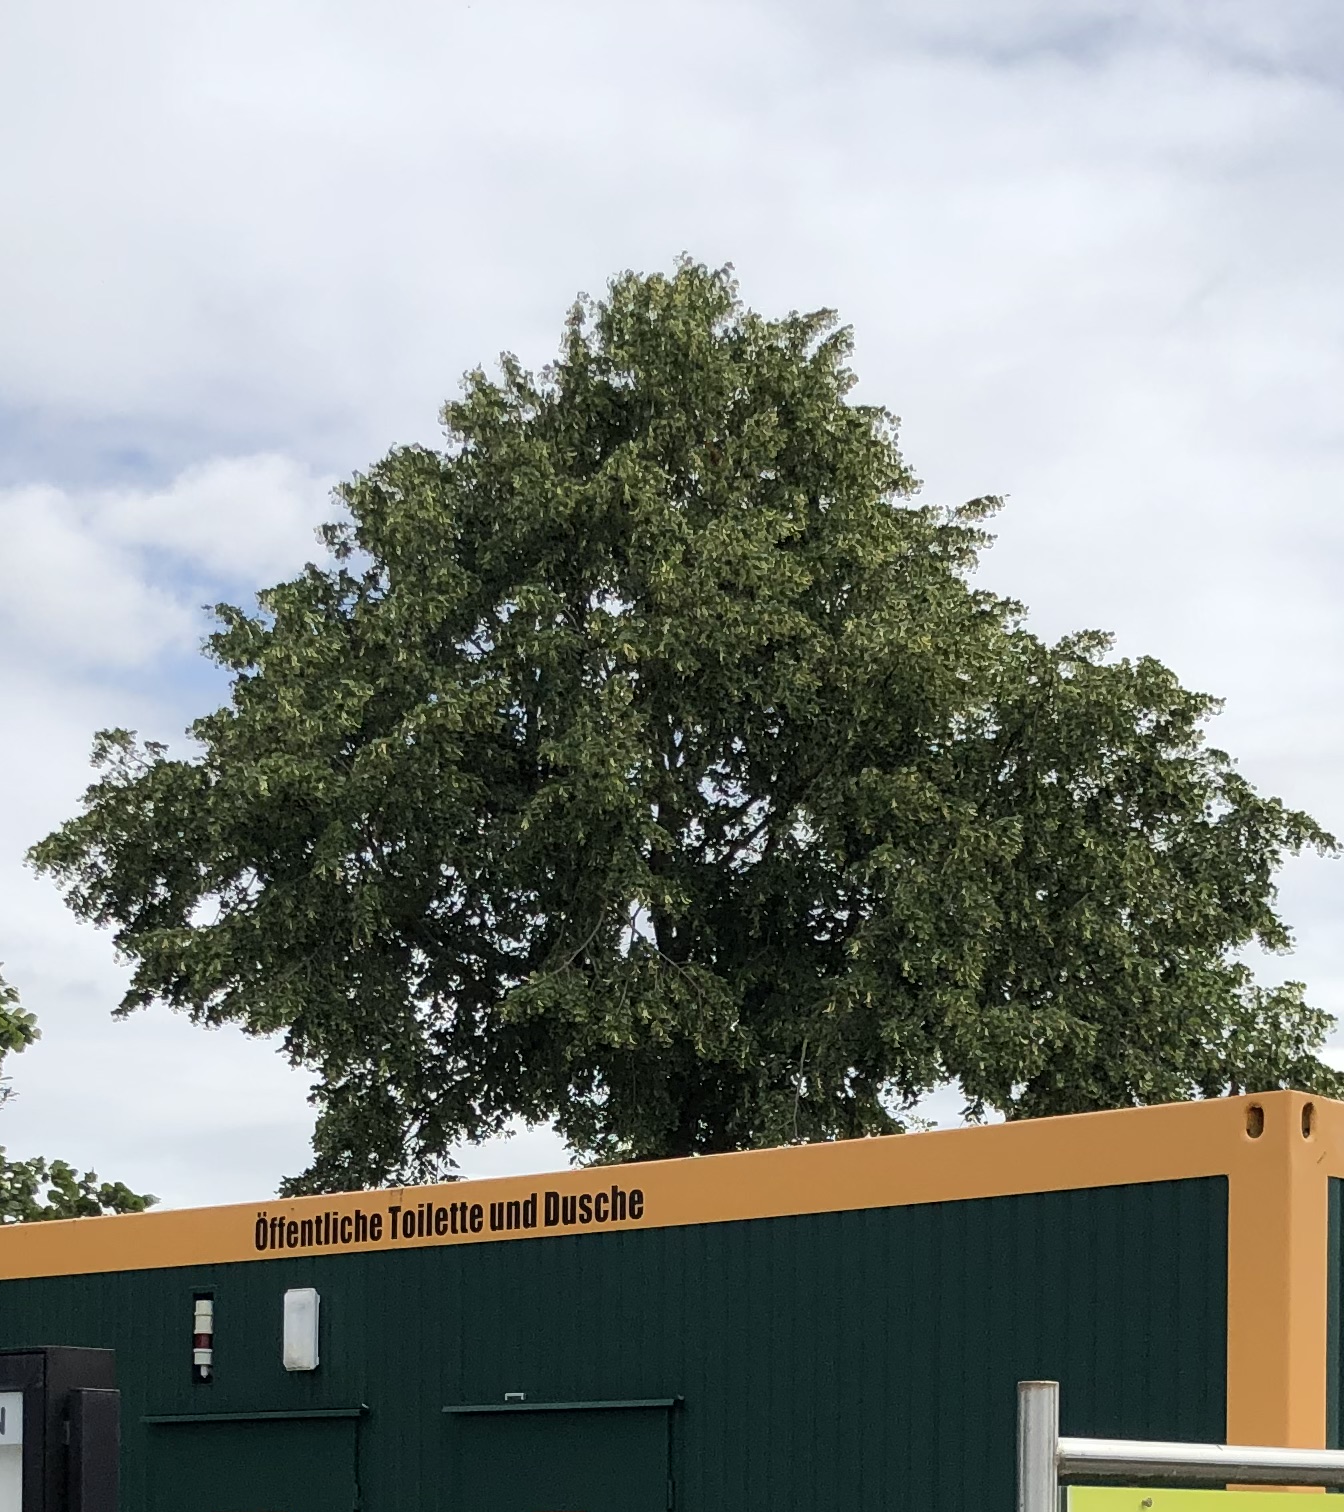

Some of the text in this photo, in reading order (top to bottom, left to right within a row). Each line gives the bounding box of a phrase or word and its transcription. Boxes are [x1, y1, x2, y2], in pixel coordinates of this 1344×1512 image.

[255, 1184, 644, 1252] Öffentliche Toilette und Dusche
